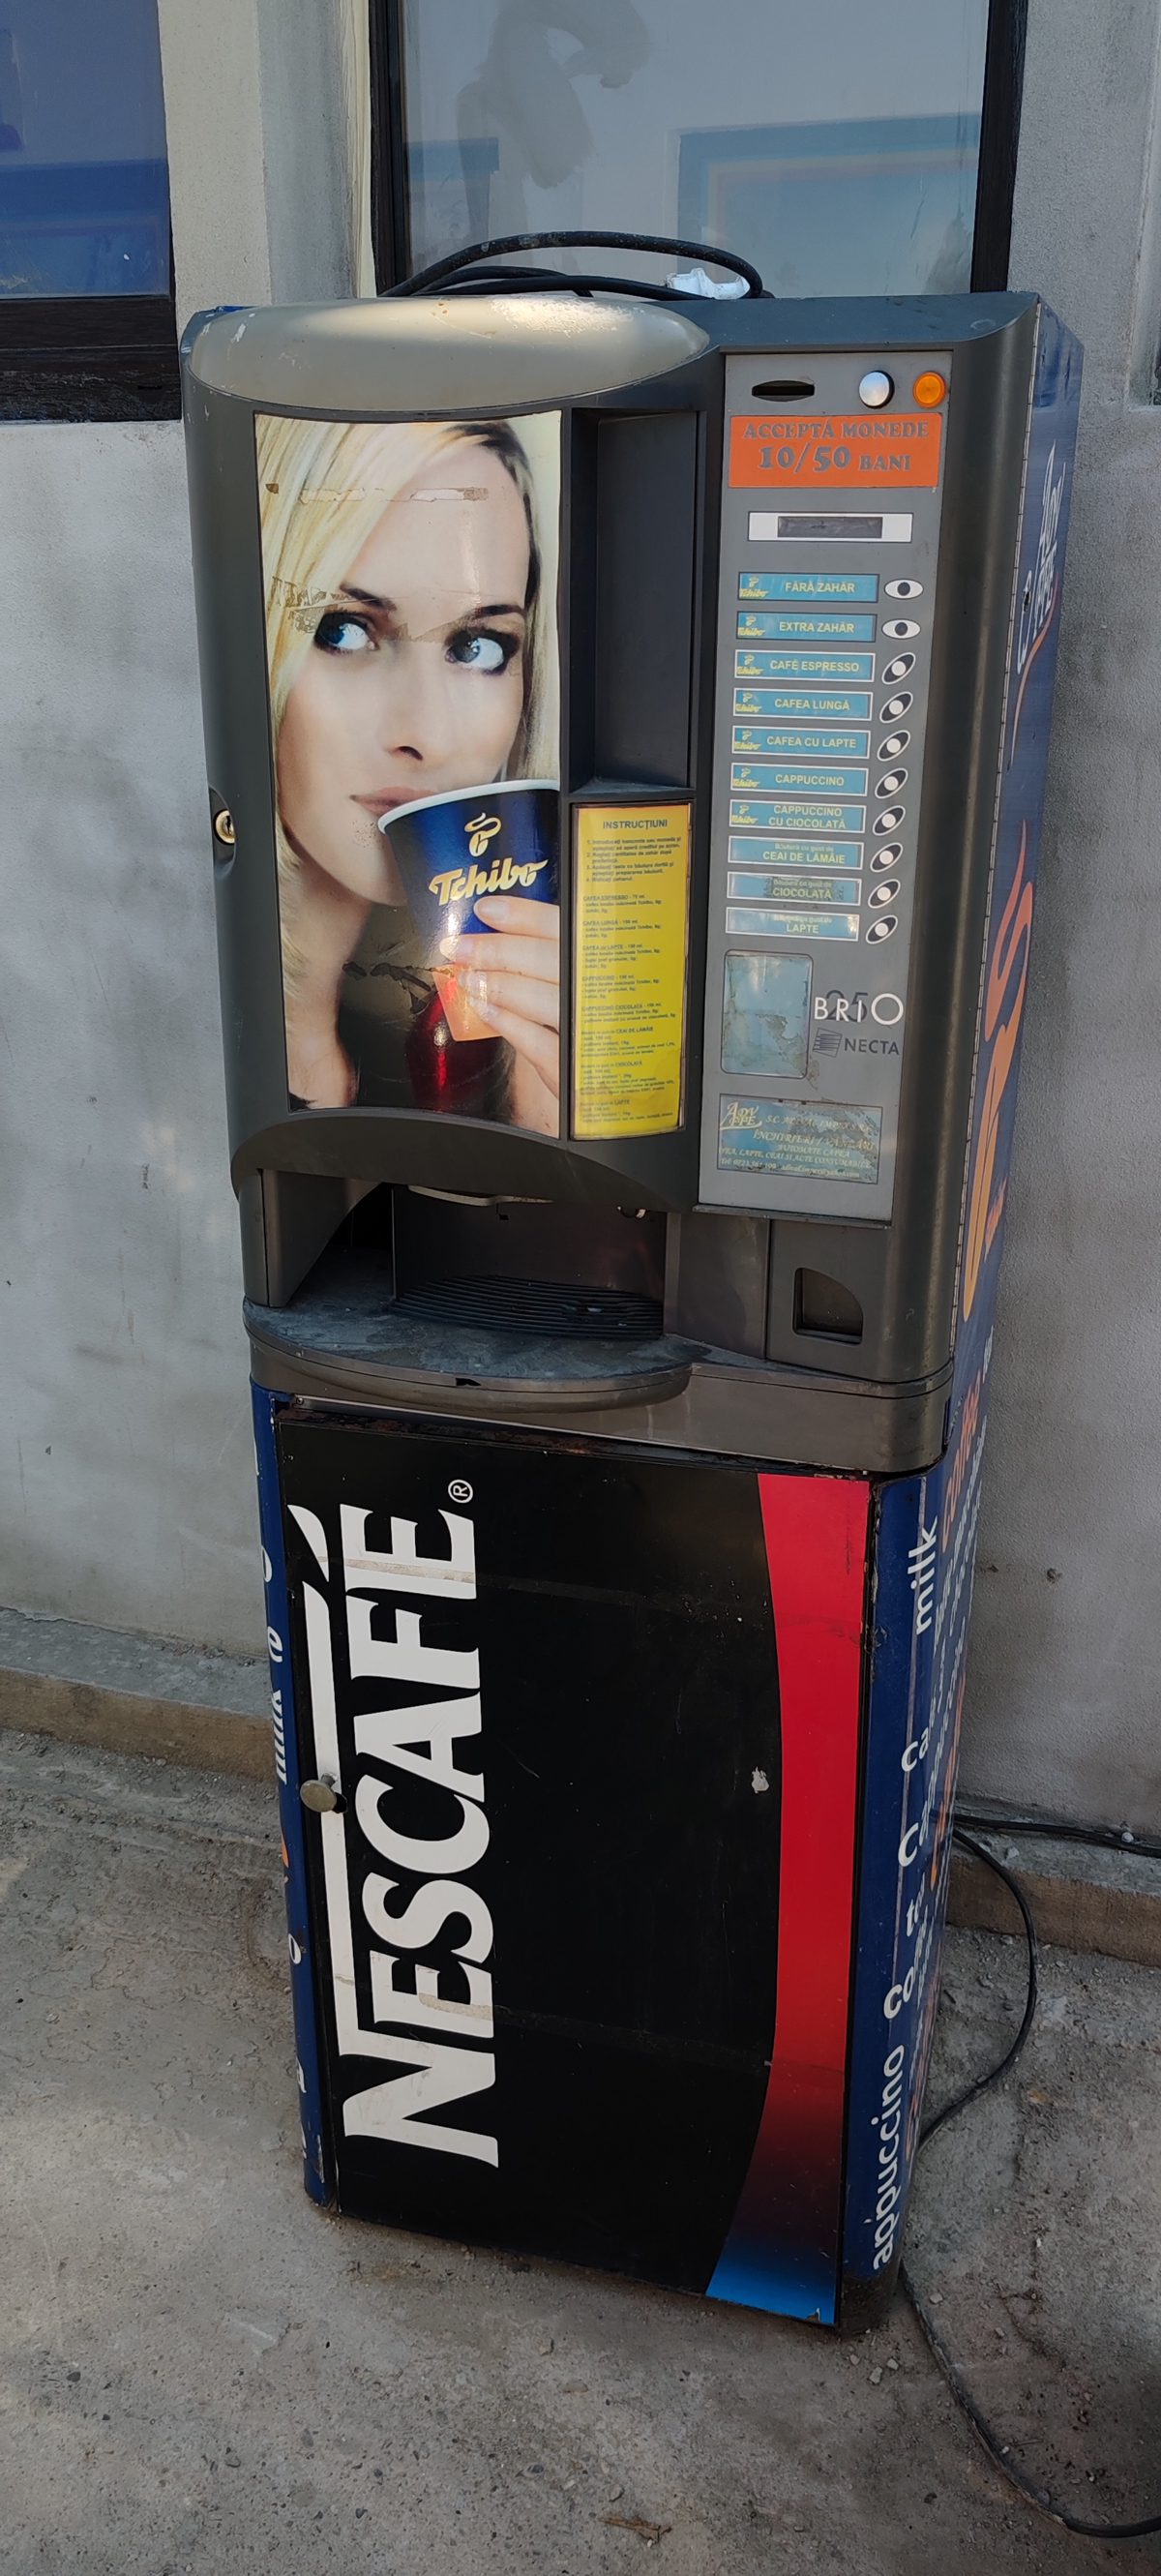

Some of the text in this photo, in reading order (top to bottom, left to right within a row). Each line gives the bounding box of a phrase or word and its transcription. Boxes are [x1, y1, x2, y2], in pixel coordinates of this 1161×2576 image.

[841, 420, 929, 438] MONEDE
[758, 442, 911, 473] 10/50 BANI
[779, 622, 814, 633] EXTRA
[801, 661, 860, 673] ESPRESSO
[775, 699, 811, 709] CAFEA
[766, 735, 856, 748] CAFEA CU LAPTE
[775, 774, 845, 786] CAPPUCCINO
[773, 805, 843, 817] CAPPUCCINO
[768, 817, 783, 826] CU
[762, 851, 788, 860] CEAI
[789, 852, 804, 862] DE
[429, 858, 549, 906] Tchibo
[786, 923, 819, 934] LAPTE
[814, 993, 904, 1025] BRIO
[844, 1037, 900, 1056] NECTA
[908, 1515, 938, 1634] milk
[288, 1504, 498, 2168] NESCAFÉ
